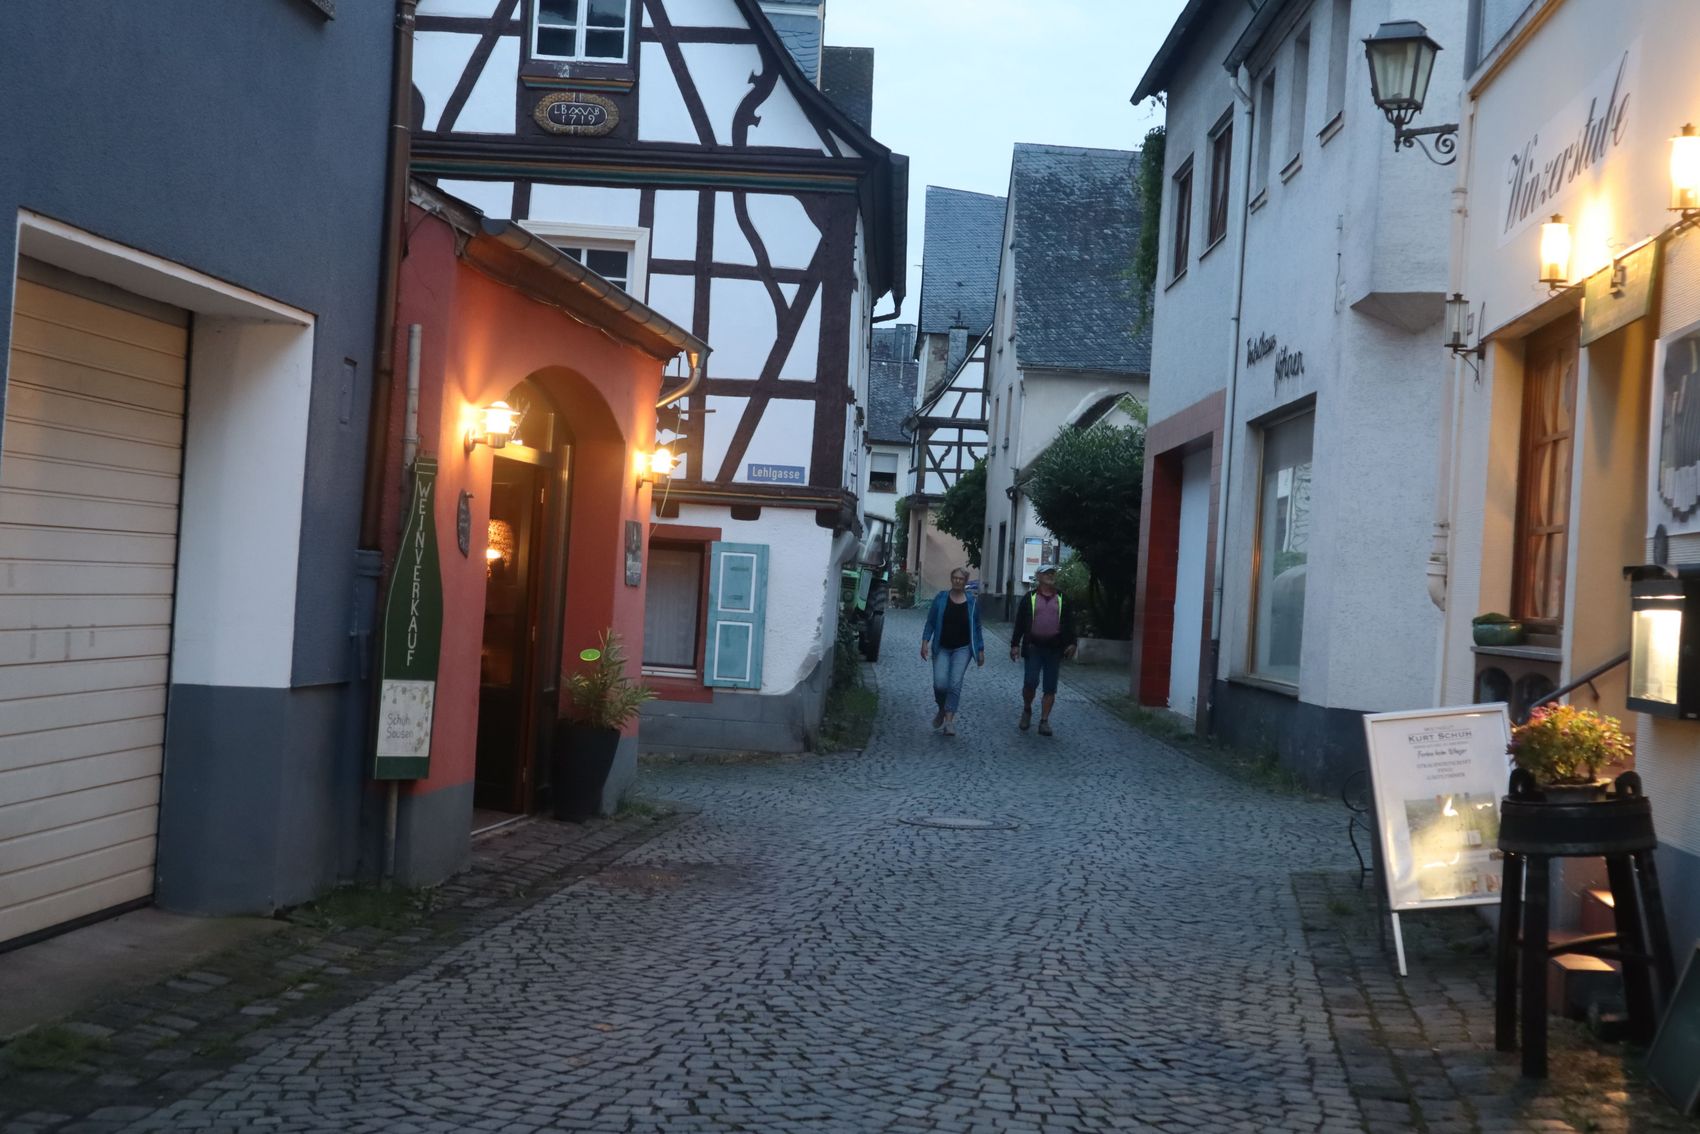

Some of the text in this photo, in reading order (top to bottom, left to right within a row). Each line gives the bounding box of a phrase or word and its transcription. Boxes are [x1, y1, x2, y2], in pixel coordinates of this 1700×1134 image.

[562, 114, 596, 125] 1719
[752, 466, 800, 481] Lehlgasse
[406, 480, 431, 666] WEINVERKAUF
